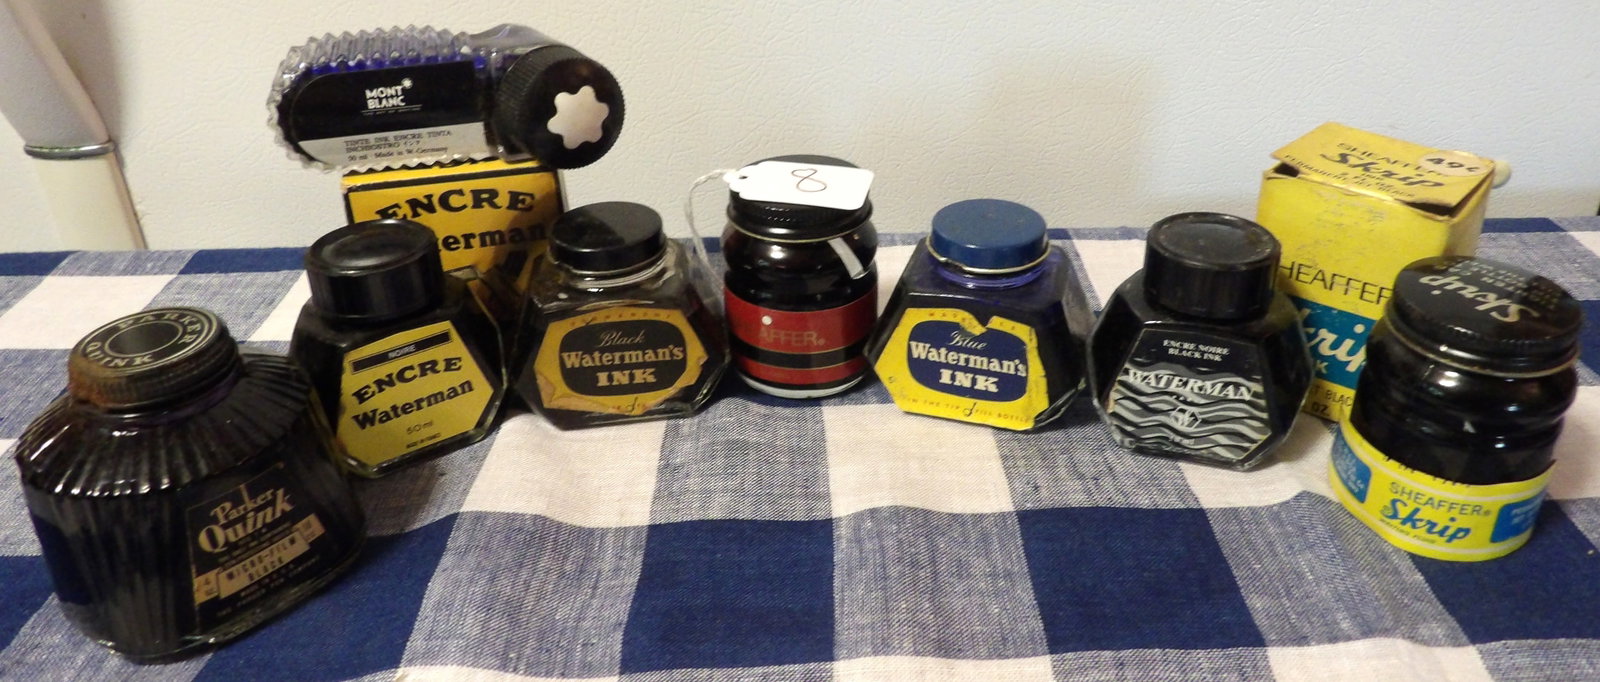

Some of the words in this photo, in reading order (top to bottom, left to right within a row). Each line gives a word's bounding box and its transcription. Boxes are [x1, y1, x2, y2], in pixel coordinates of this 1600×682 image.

[365, 86, 403, 99] MONT
[367, 96, 406, 109] BLANC
[791, 168, 827, 192] 8
[1319, 152, 1446, 187] Skrip
[374, 188, 536, 221] ENCRE
[441, 222, 546, 251] erman
[1418, 275, 1540, 323] Skrip
[117, 313, 202, 345] PARKER
[598, 329, 646, 347] Black
[948, 330, 988, 350] Blue
[86, 341, 154, 367] QUINK
[561, 345, 684, 369] Waterman's
[909, 341, 1027, 377] Waterman's
[1162, 339, 1197, 350] ENCRE
[1168, 348, 1202, 359] BLACK
[1203, 352, 1223, 362] INK
[352, 356, 462, 405] ENCRE
[596, 368, 657, 387] INK
[938, 369, 999, 393] INK
[1127, 368, 1254, 401] WATERMAN
[352, 380, 474, 430] Waterman
[210, 484, 275, 525] Parker
[198, 488, 295, 553] Quink
[1380, 497, 1471, 544] Skrip
